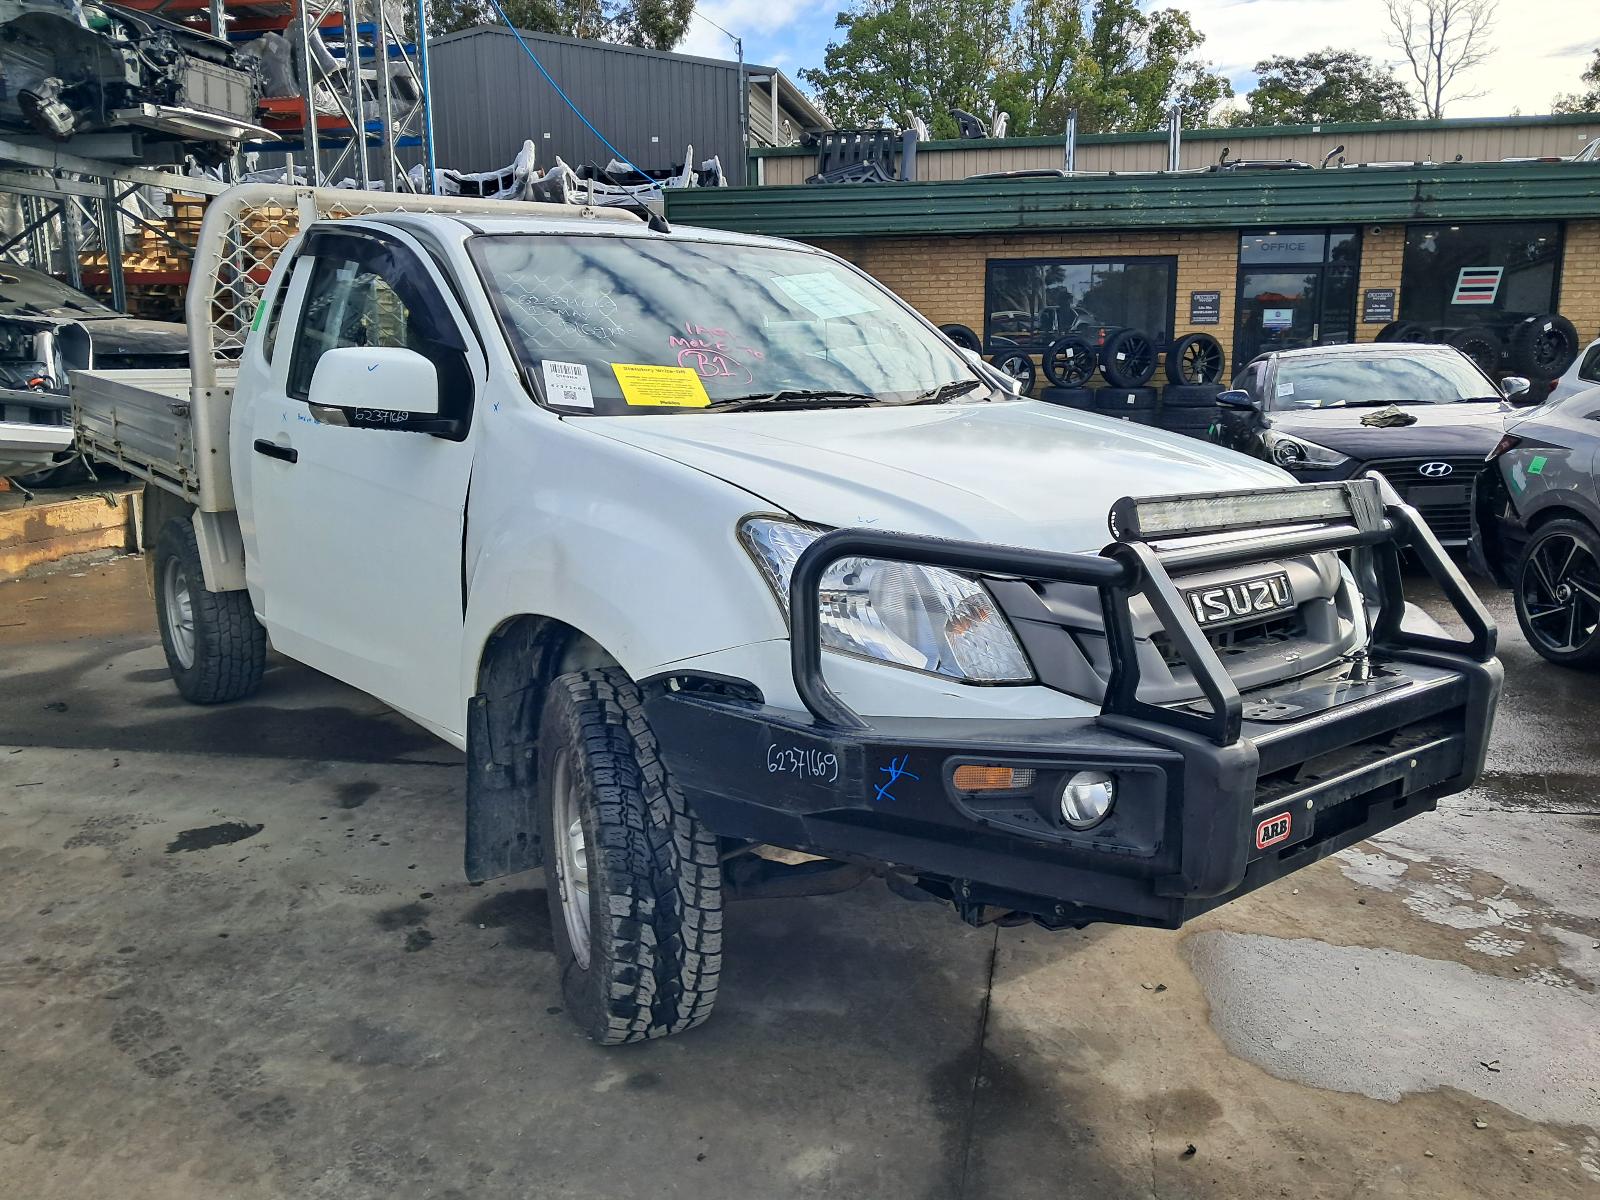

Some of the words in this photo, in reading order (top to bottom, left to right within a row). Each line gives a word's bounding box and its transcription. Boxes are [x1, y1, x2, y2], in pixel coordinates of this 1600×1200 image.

[1261, 242, 1305, 251] OFFICE
[1190, 576, 1290, 623] ISUZU
[766, 743, 839, 783] 62371669
[1261, 819, 1288, 843] ARB
